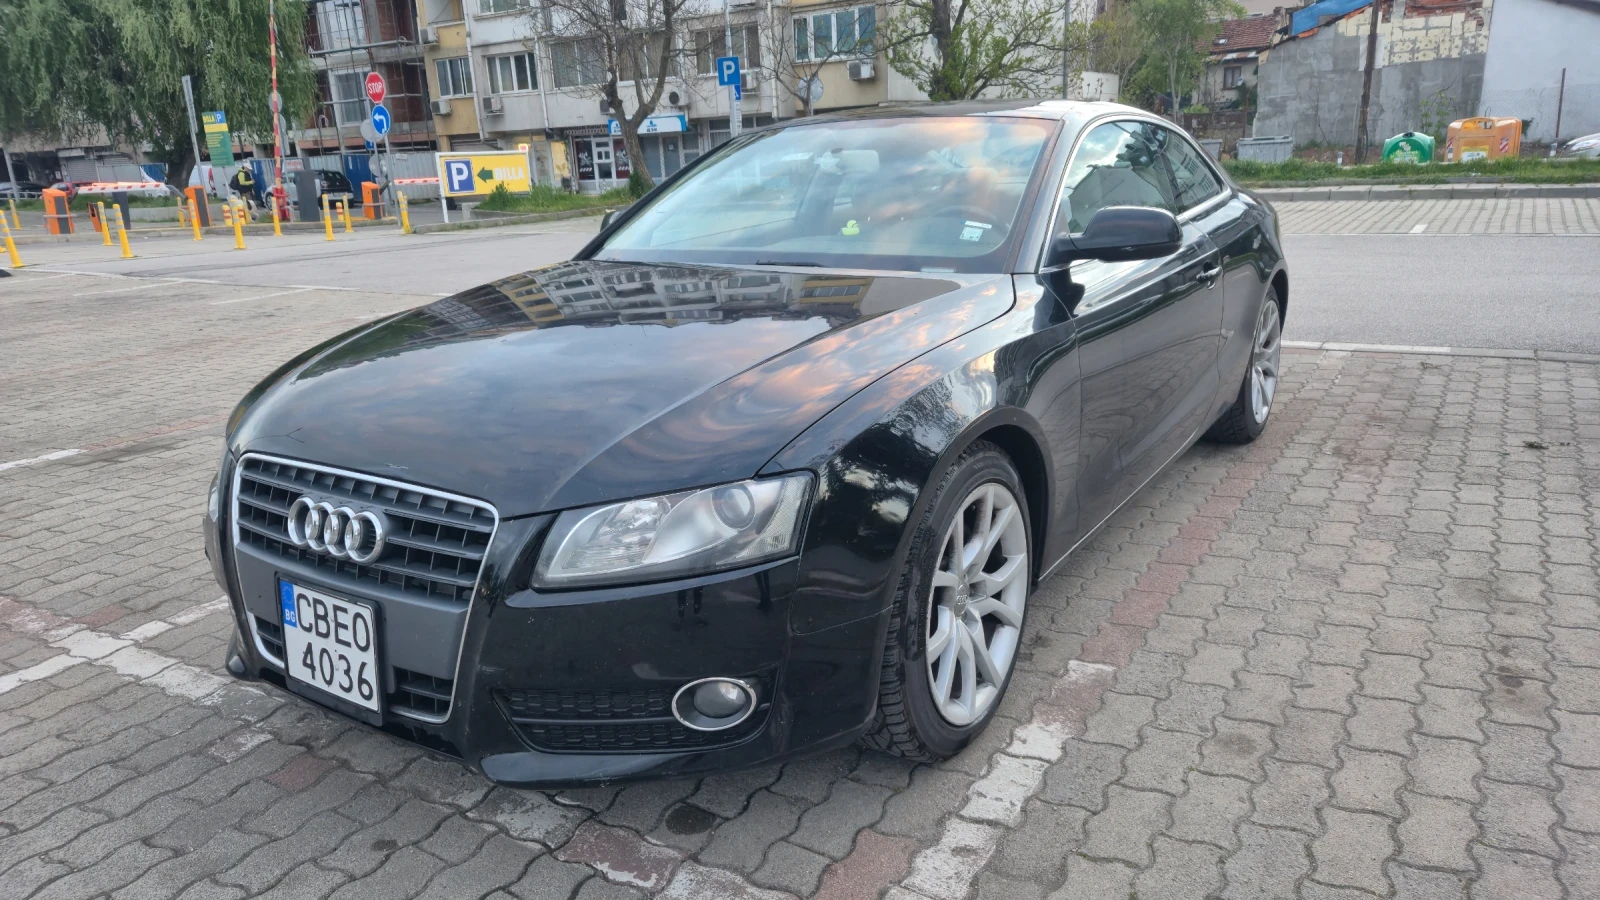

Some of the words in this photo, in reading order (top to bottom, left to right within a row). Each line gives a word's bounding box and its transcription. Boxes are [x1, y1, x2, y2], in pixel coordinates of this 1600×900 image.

[723, 61, 736, 83] P
[368, 82, 382, 94] STOP
[216, 113, 222, 122] P
[450, 162, 469, 191] P
[494, 166, 525, 181] BILLA
[286, 609, 295, 622] BG
[302, 642, 373, 701] 4036
